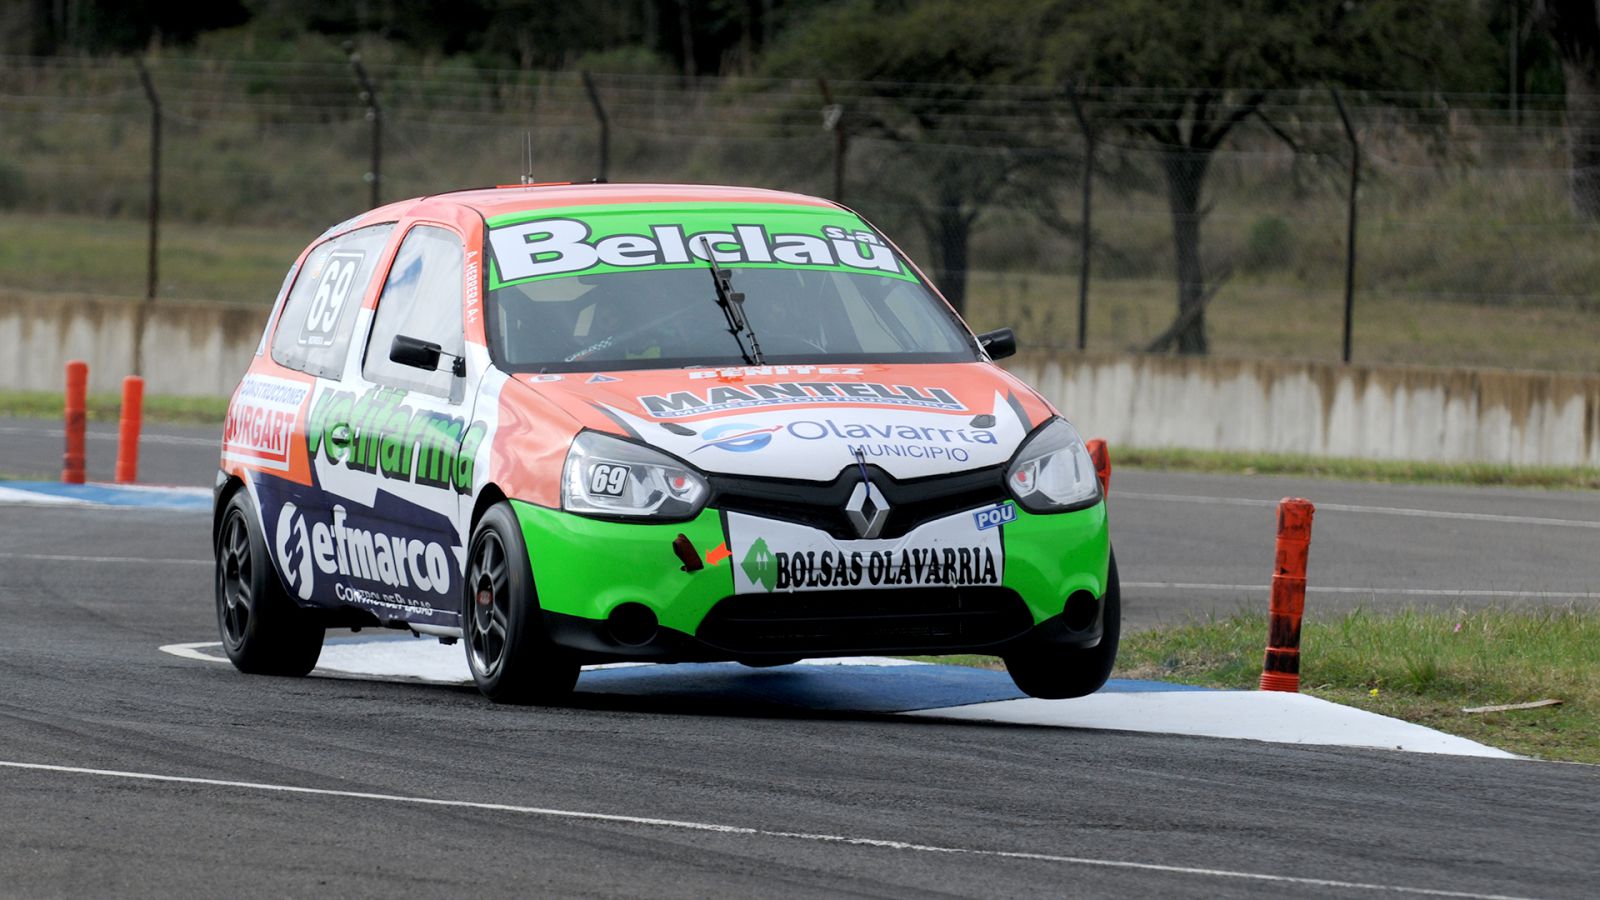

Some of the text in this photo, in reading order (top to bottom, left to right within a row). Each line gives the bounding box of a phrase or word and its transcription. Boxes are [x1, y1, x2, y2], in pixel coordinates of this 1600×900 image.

[489, 217, 904, 282] Belclau
[307, 259, 355, 333] 69
[466, 262, 479, 308] HERRERA
[638, 382, 962, 413] MANTELLI
[848, 444, 970, 462] MUNICIPIO
[591, 465, 628, 495] 69
[978, 507, 1014, 527] POU
[775, 547, 998, 589] BOLSAS OLAVARRIA
